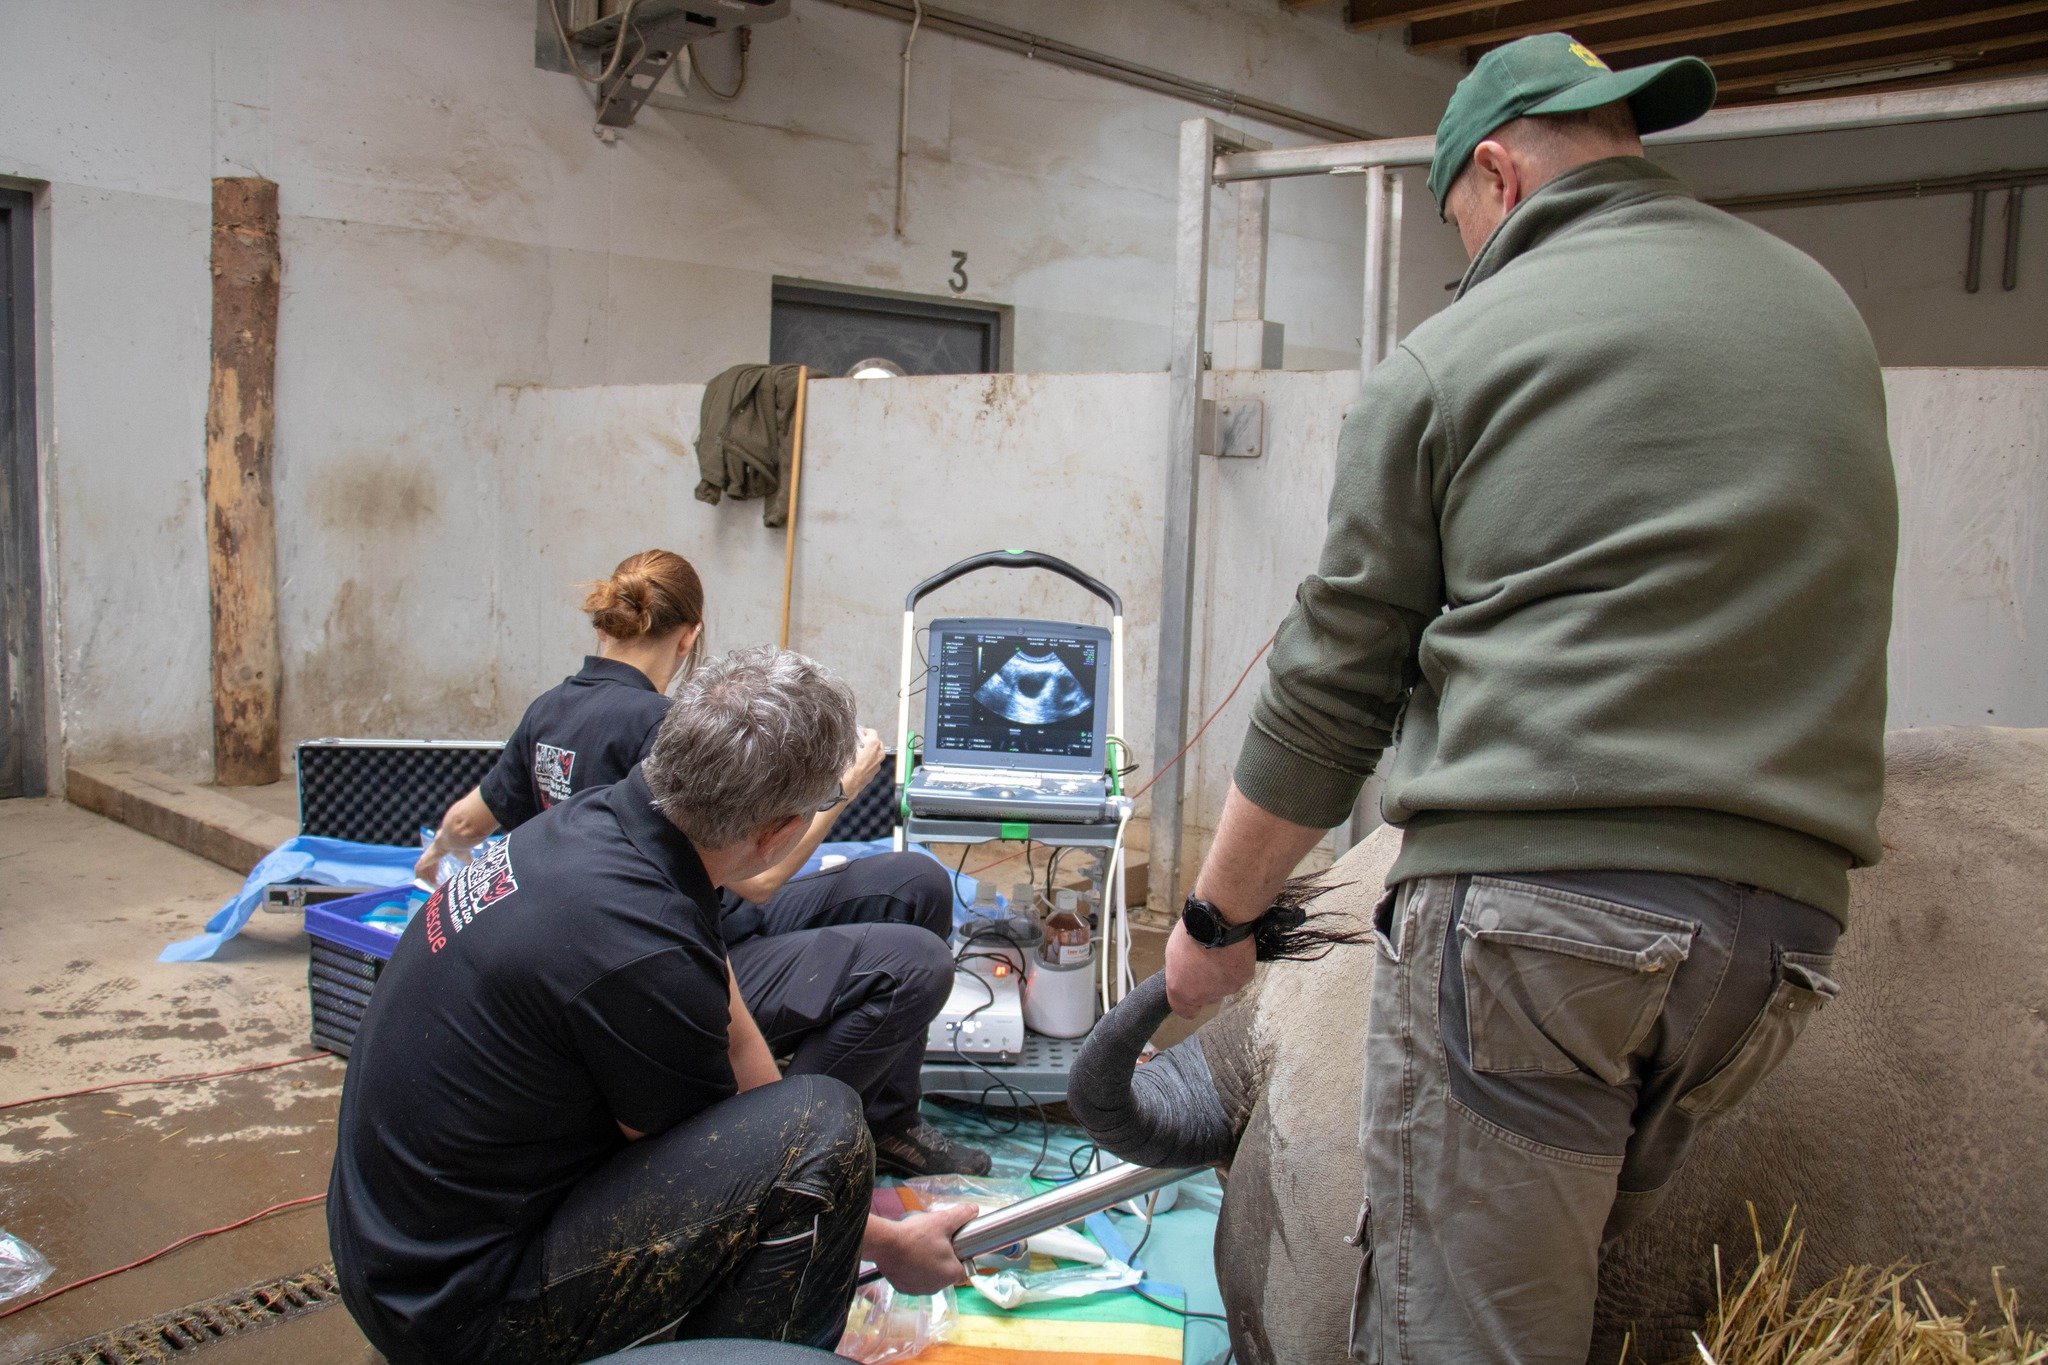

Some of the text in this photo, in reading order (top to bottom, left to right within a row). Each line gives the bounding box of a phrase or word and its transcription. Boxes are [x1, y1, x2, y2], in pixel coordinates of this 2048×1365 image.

[948, 250, 969, 294] 3
[426, 884, 447, 953] oRescue
[450, 909, 463, 933] Berlin
[461, 906, 473, 924] Zoo
